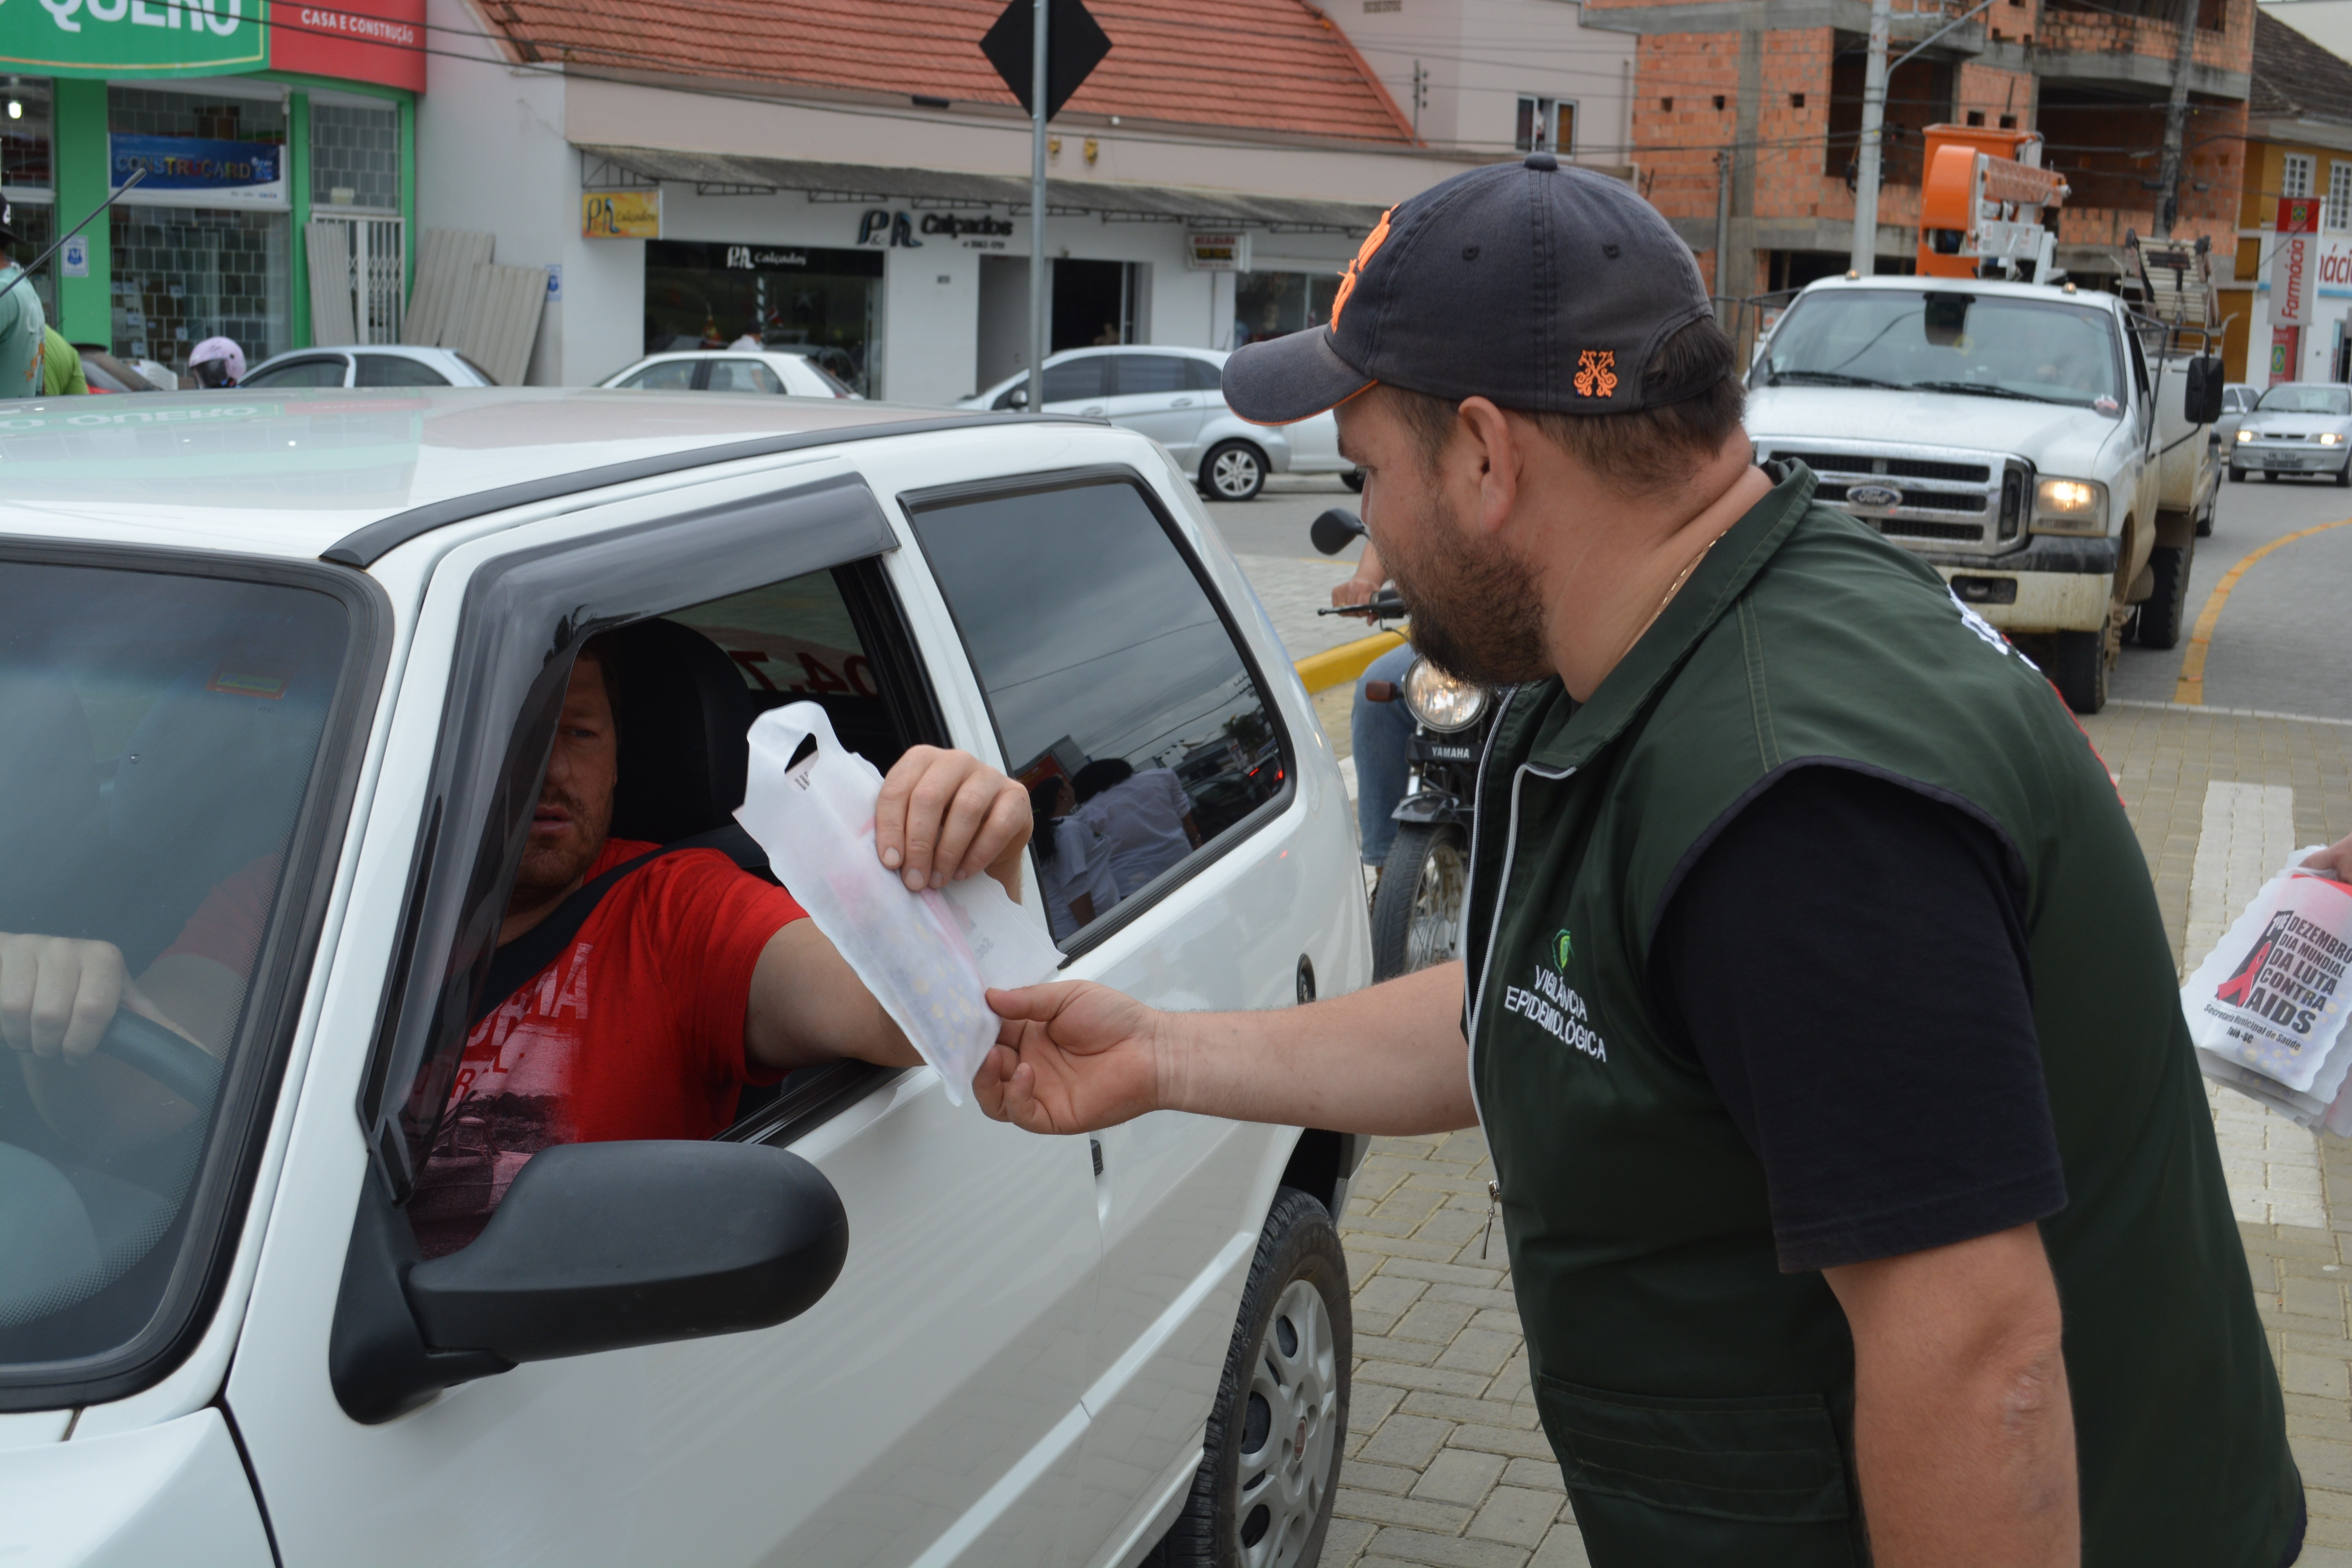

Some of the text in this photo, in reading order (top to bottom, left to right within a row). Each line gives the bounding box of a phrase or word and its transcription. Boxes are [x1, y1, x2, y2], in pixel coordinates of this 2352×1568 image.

[301, 9, 414, 44] CASA E CONSTRUÇÃO
[115, 157, 251, 180] CONSTRUCARD
[921, 213, 1014, 239] Calçados
[2281, 239, 2305, 320] Farmácia
[1432, 746, 1470, 759] YAMAHA
[2278, 934, 2346, 978] DIA MUNDIAL
[2287, 916, 2352, 964] DEZEMBRO
[1534, 965, 1588, 1022] VIGILÂNCIA
[2259, 967, 2327, 1012] CONTRA
[2268, 948, 2338, 996] DA LUTA
[1504, 985, 1606, 1062] EPIDEMIOLÓGICA
[2204, 1004, 2301, 1051] Secretaria Municipal de Saúde
[2243, 987, 2316, 1034] AIDS
